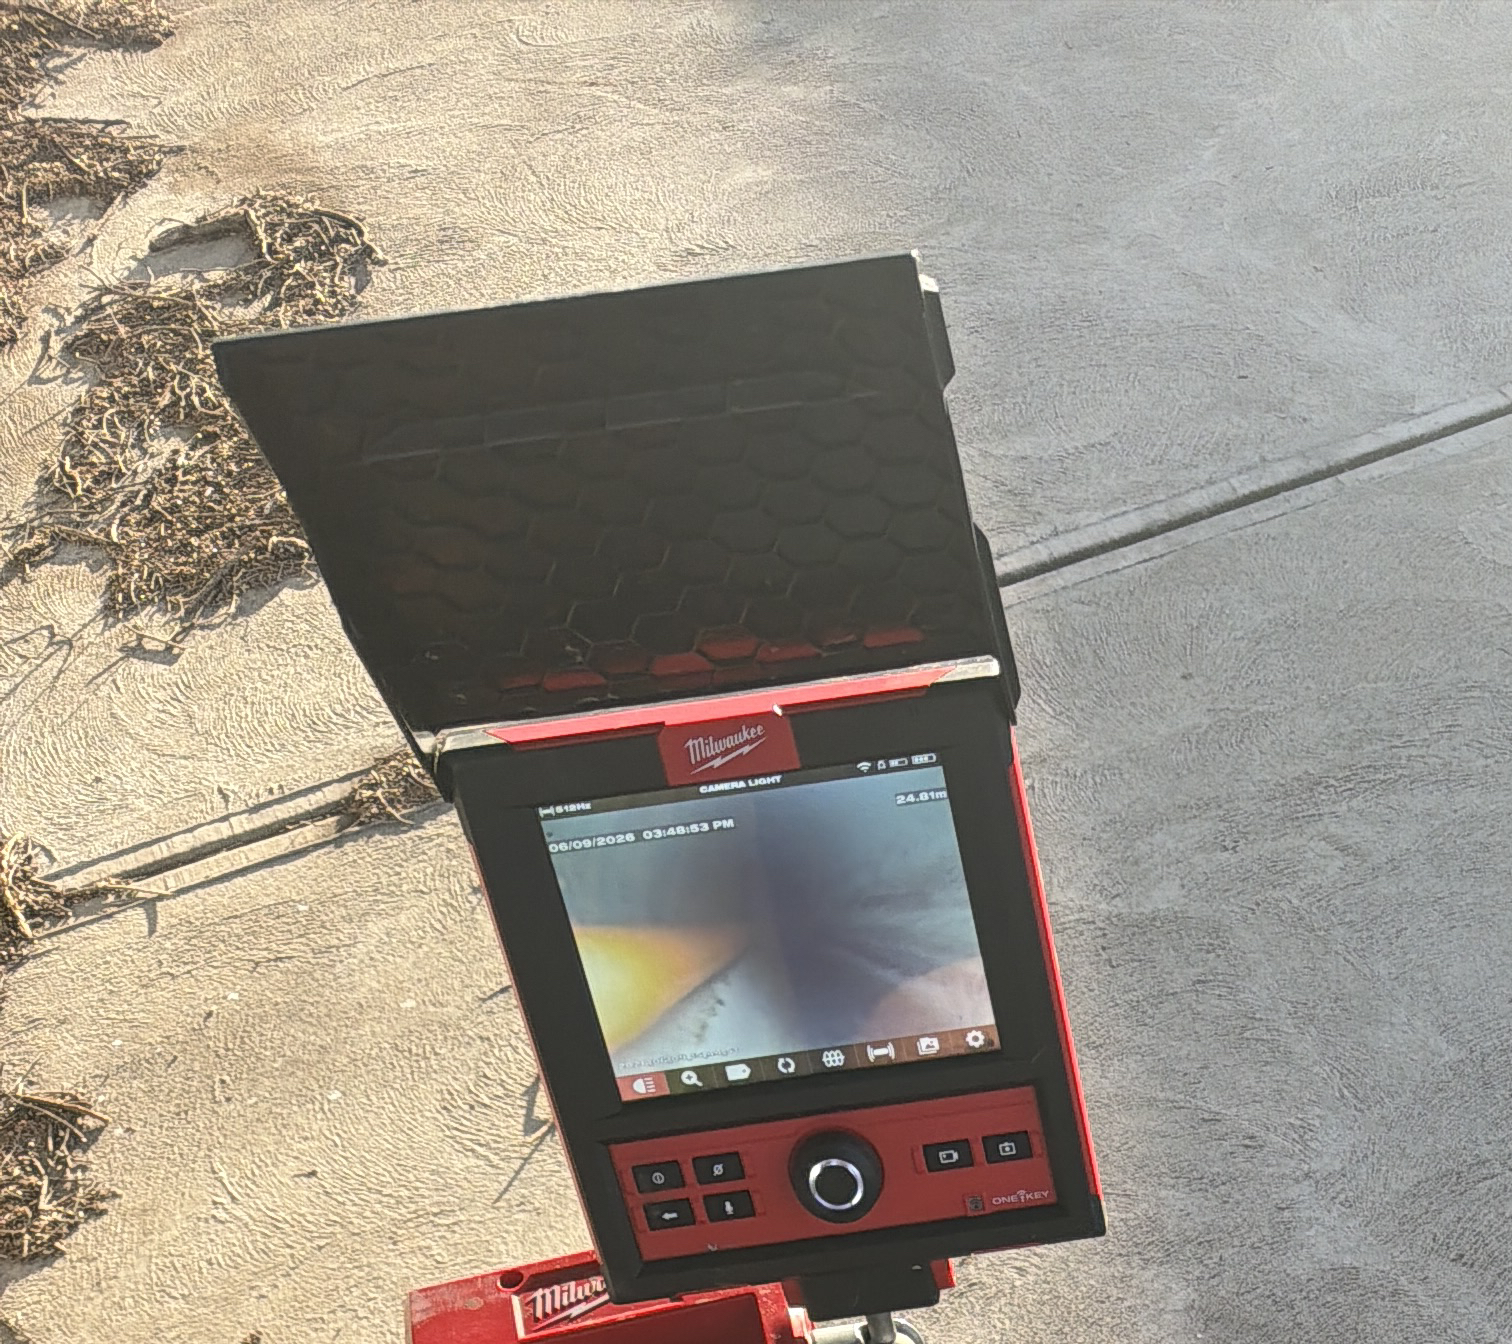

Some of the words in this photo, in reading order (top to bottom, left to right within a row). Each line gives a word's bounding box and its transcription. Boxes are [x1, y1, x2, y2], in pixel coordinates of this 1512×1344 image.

[684, 724, 765, 764] Milwaukee
[699, 780, 746, 793] CAMERA
[748, 775, 783, 787] LIGHT
[896, 790, 948, 805] 24.81m
[549, 832, 636, 853] 06/09/2026
[643, 819, 710, 840] 03:48:53
[712, 818, 735, 831] PM
